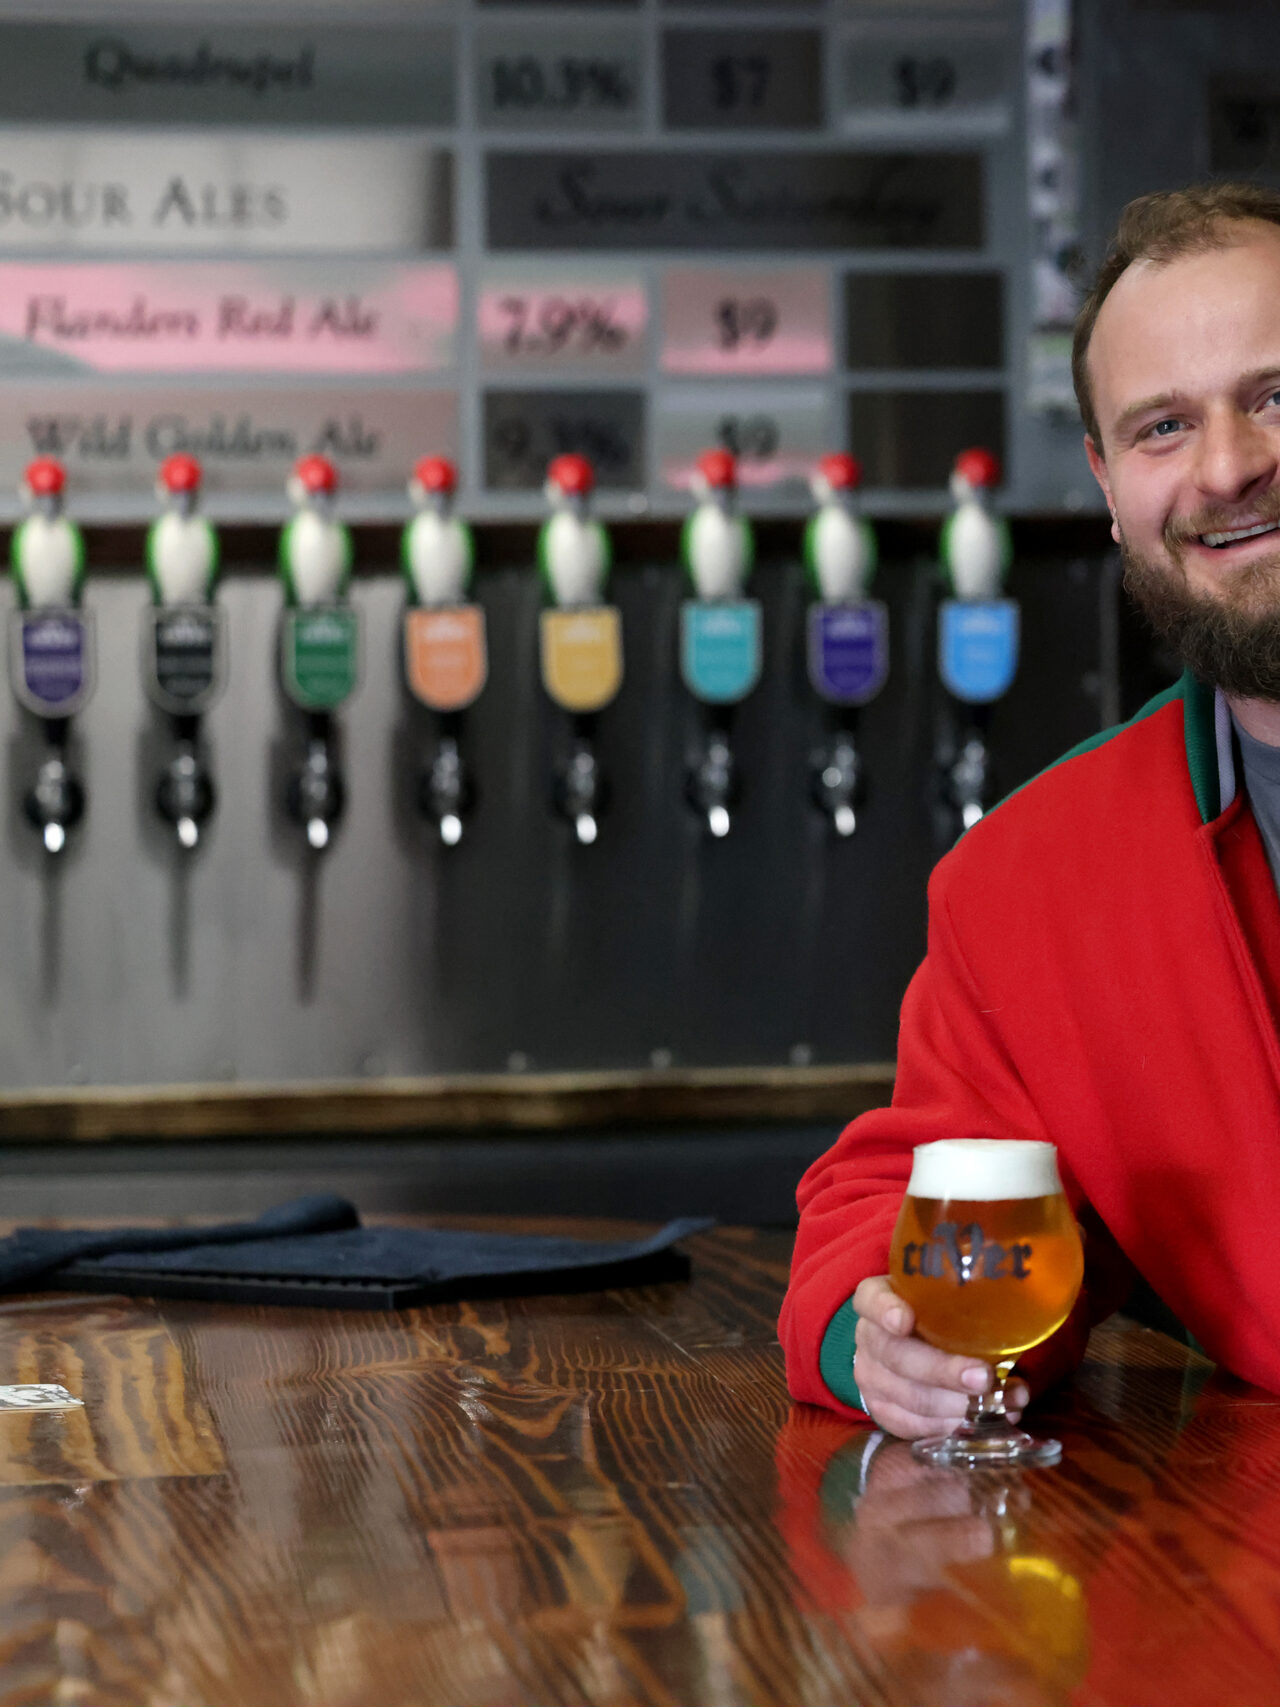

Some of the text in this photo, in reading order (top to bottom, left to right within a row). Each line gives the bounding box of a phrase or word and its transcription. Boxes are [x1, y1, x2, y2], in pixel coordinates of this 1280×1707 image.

[154, 176, 289, 227] ALES
[218, 296, 295, 341] Red
[310, 299, 378, 341] Ale
[716, 299, 778, 352] $9
[26, 414, 378, 458] Wild Golden Ale
